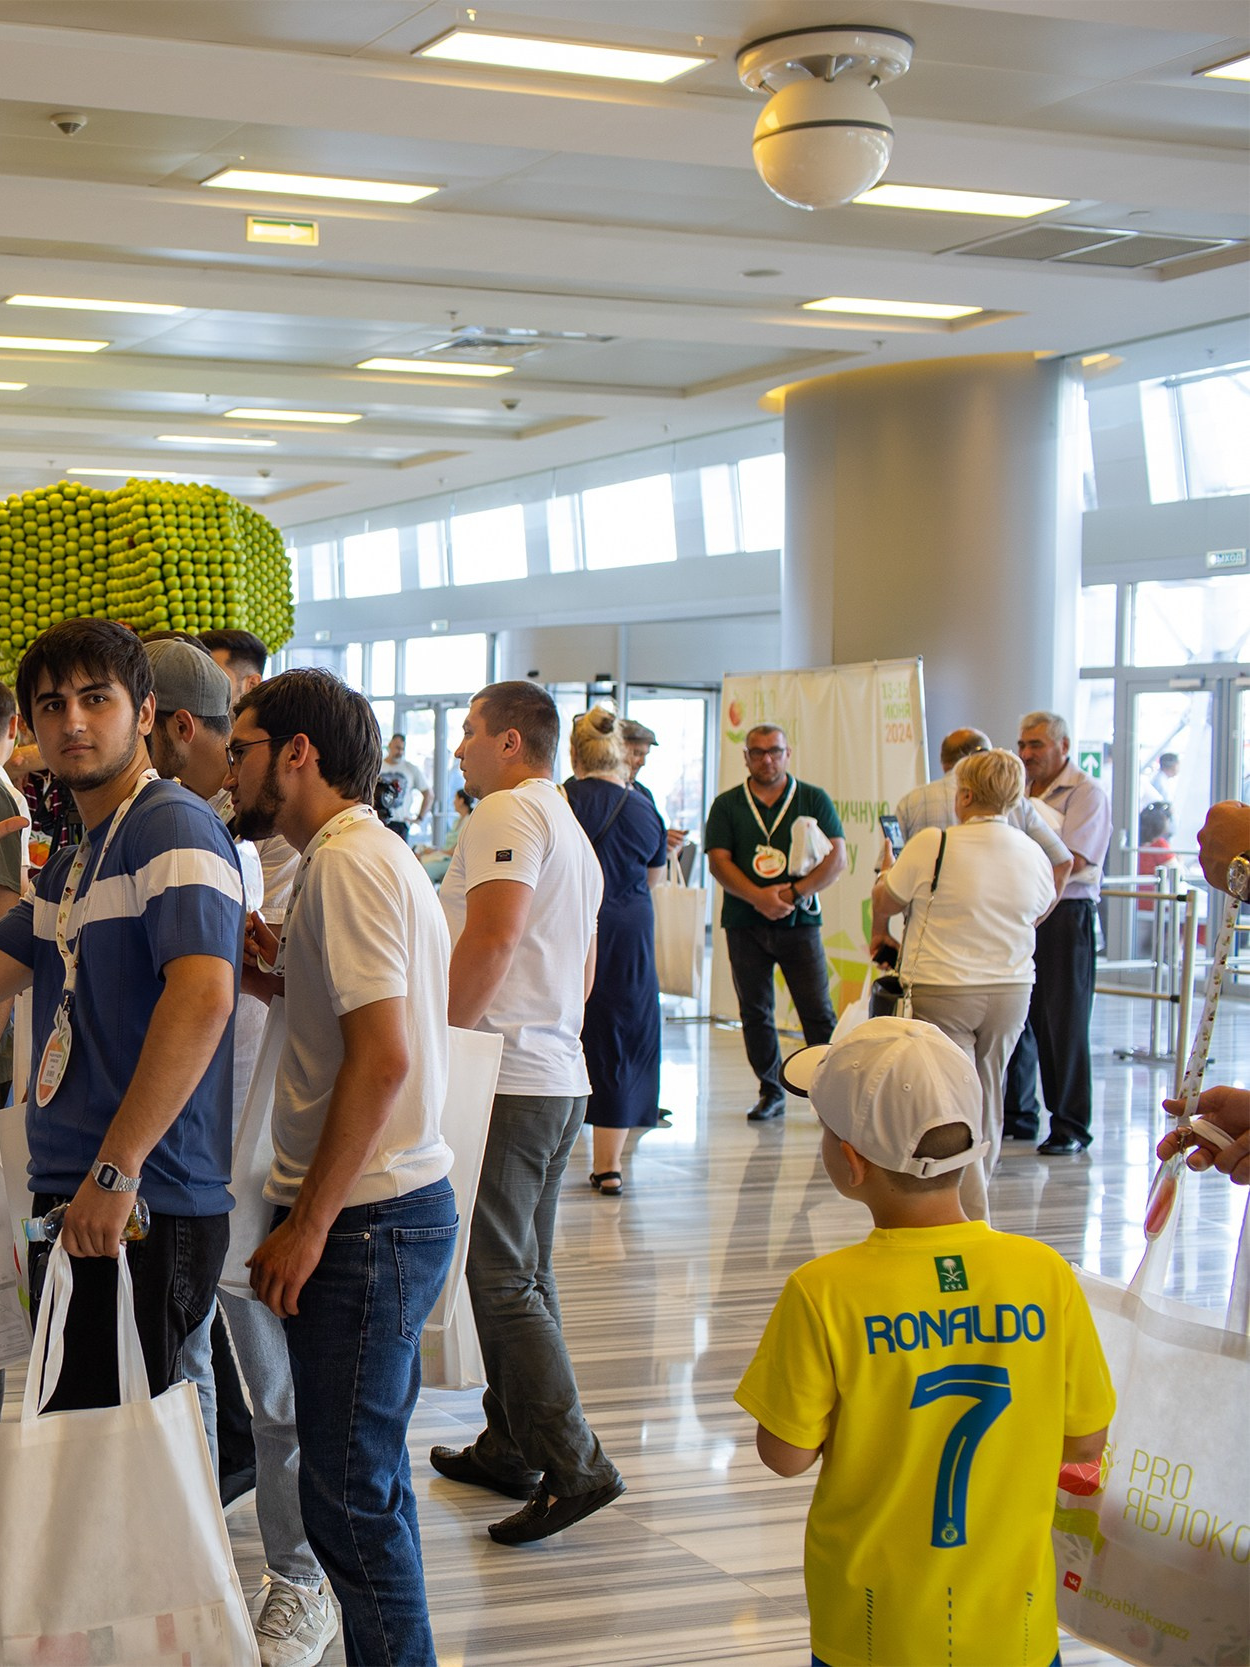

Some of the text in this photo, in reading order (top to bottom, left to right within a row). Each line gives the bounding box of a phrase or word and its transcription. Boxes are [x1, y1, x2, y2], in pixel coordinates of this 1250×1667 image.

[885, 722, 913, 743] 2024
[943, 1283, 964, 1291] KSA
[863, 1303, 1047, 1355] RONALDO
[909, 1364, 1013, 1549] 7
[1128, 1448, 1193, 1501] PRO
[1122, 1487, 1250, 1564] ЯБЛОКО
